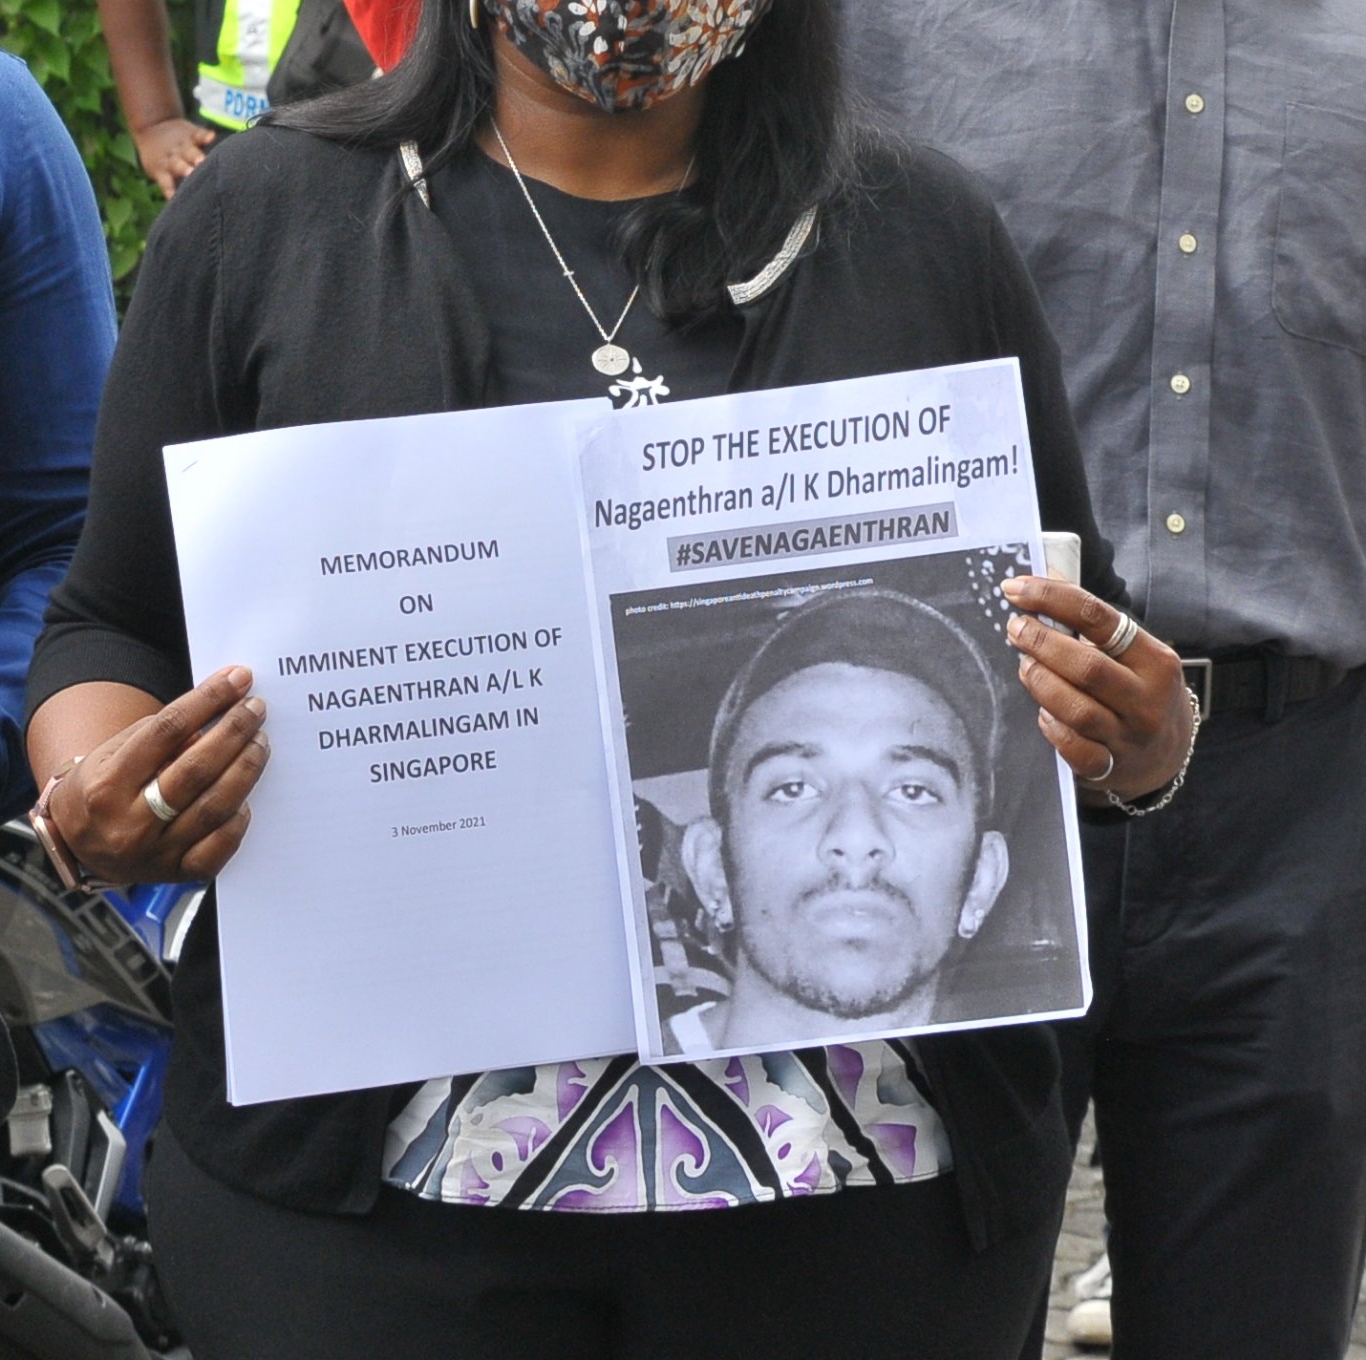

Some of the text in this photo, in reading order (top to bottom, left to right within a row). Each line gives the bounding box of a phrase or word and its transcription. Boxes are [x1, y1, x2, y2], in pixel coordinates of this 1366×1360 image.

[642, 404, 952, 471] STOP THE EXECUTION OF
[595, 484, 753, 530] Nagaenthran
[804, 472, 820, 501] K
[827, 444, 1019, 499] Dharmalingam!
[320, 540, 499, 576] MEMORANDUM
[676, 510, 950, 567] #SAVENAGAENTHRAN
[399, 594, 433, 614] ON
[625, 605, 646, 616] photo
[278, 627, 562, 676] IMMINENT EXECUTION OF
[308, 667, 543, 712] NAGAENTHRAN A/L K
[319, 707, 539, 750] DHARMALINGAM IN
[370, 750, 497, 783] SINGAPORE
[391, 816, 486, 838] 3 November 2021
